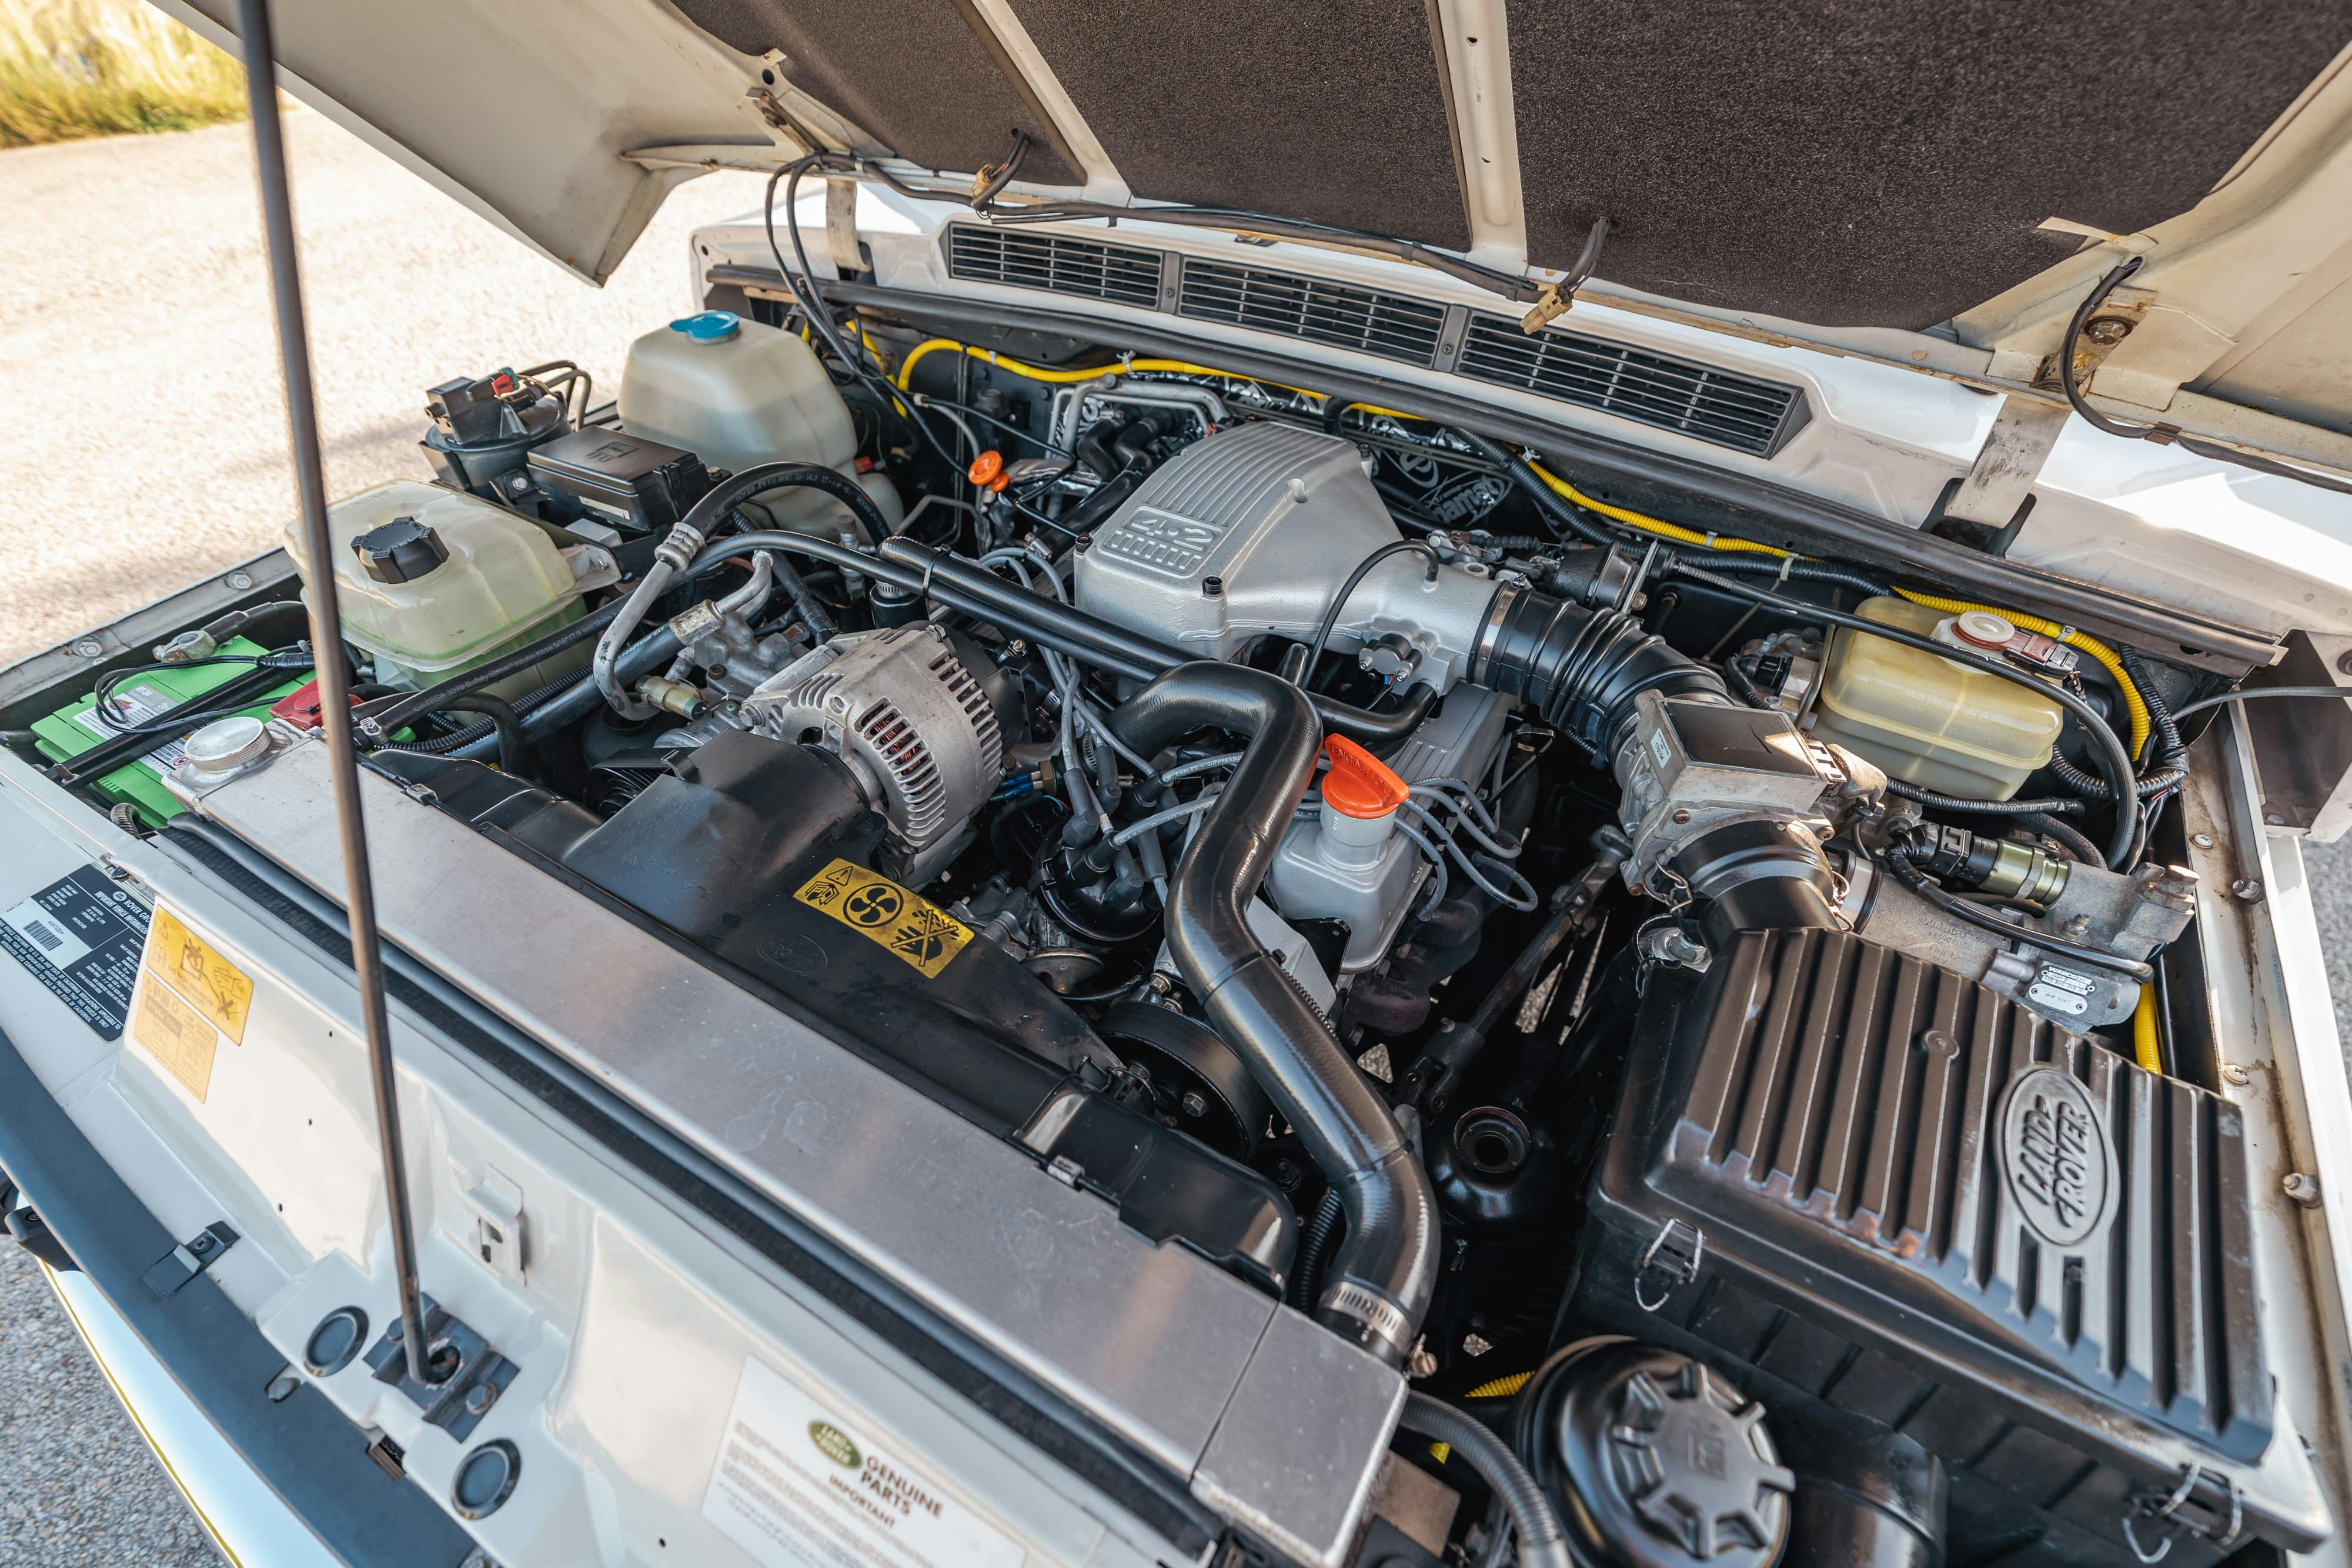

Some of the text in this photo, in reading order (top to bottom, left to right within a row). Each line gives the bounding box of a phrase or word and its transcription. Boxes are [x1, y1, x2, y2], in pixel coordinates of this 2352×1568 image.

[464, 674, 490, 688] Safety
[514, 652, 536, 667] Heater
[535, 644, 553, 656] Hose
[617, 635, 652, 660] GOODYEAR
[1175, 765, 1198, 777] CABLES
[1207, 755, 1241, 767] SUPPRESSIO
[1331, 745, 1392, 797] ENGINE OIL
[93, 890, 116, 907] IMPORTANT
[111, 905, 129, 917] VEHICLE
[122, 900, 151, 924] ROVER GRO
[13, 934, 29, 948] CONFORMS
[50, 967, 61, 975] STATE
[63, 978, 81, 994] CALIFORNIA
[79, 992, 100, 1011] REGULATIONS
[98, 1009, 117, 1026] APPLICABLE
[24, 961, 41, 975] COMMERCE
[44, 978, 54, 987] SALE
[60, 994, 71, 1002] STATE
[73, 1005, 92, 1022] CALIFORNIA.
[44, 969, 58, 981] VEHICLES
[56, 981, 71, 994] PROVIDED
[83, 1005, 97, 1017] VEHICLE
[98, 1019, 110, 1028] ONLY
[2018, 1108, 2056, 1206] LAND
[2053, 1101, 2090, 1218] ROVER
[818, 1439, 852, 1465] ROVER
[819, 1424, 848, 1450] LAND
[829, 1473, 896, 1529] IMPORTANT
[861, 1471, 911, 1516] PARTS
[866, 1455, 944, 1519] GENUINE
